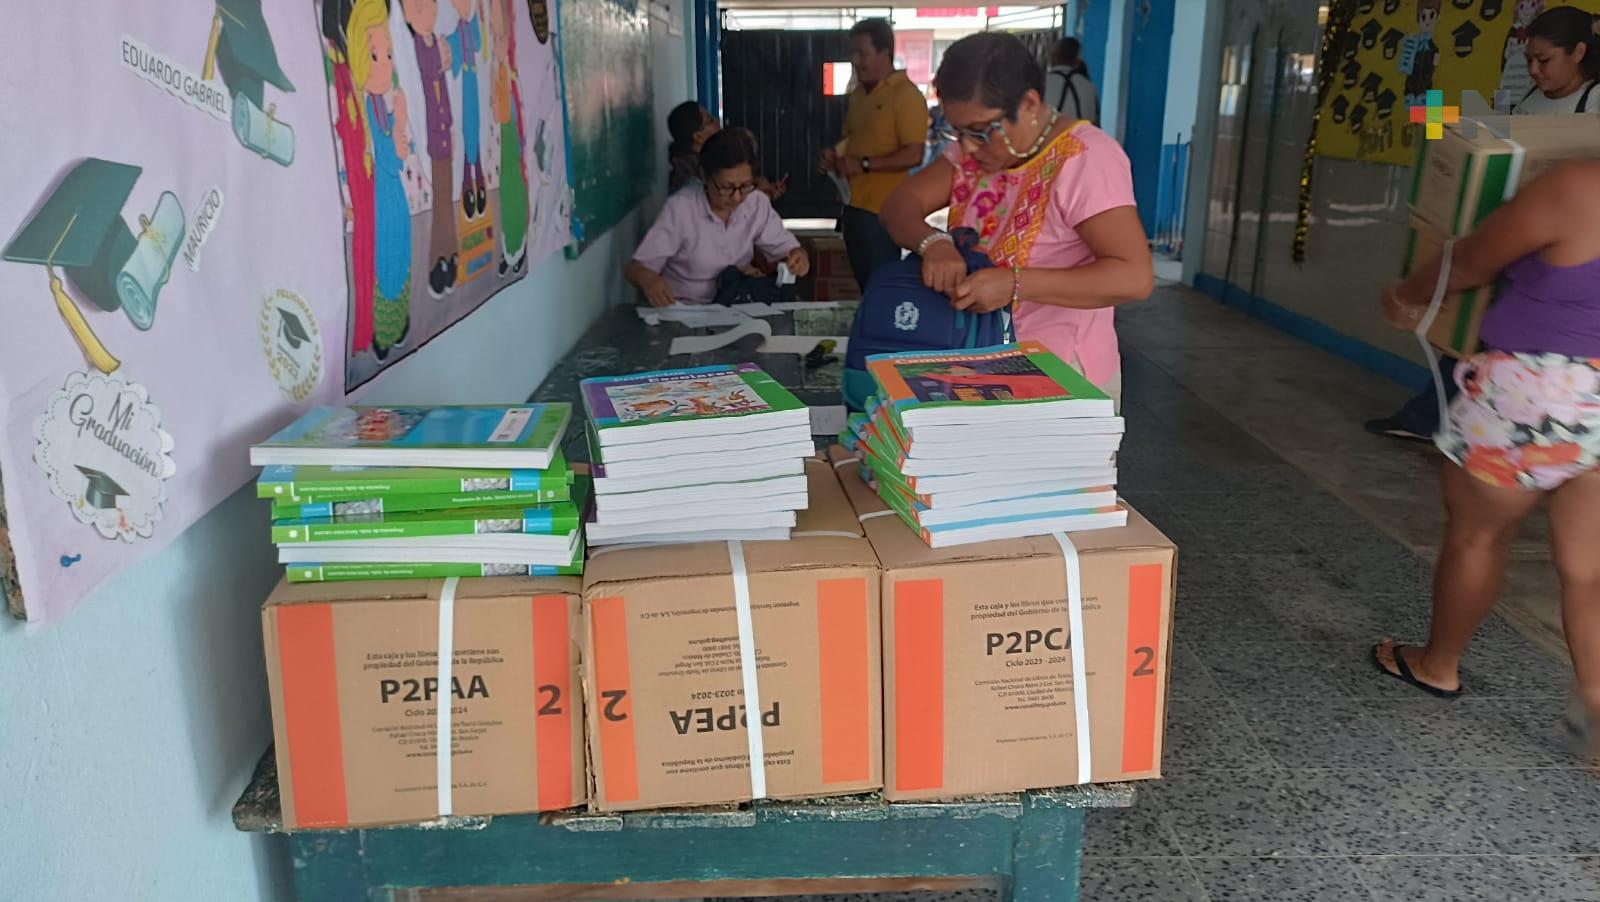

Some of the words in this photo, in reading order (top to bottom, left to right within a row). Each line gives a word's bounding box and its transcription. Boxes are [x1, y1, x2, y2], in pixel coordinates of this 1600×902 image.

[122, 41, 181, 90] EDUARDO
[184, 77, 227, 114] GABRIEL
[183, 189, 220, 267] MAURICIO
[648, 370, 734, 383] Escolares
[107, 392, 135, 434] Mi
[69, 393, 159, 477] Graduación
[971, 610, 1006, 620] propiedad
[1007, 609, 1017, 617] del
[1019, 608, 1049, 616] Gobierno
[990, 602, 1004, 610] caja
[1005, 659, 1023, 668] Ciclo
[1025, 658, 1042, 666] 2023
[1048, 656, 1066, 664] 2024
[1133, 646, 1154, 677] 2
[381, 675, 489, 703] P2PAA
[538, 684, 562, 716] 2
[405, 708, 425, 717] Ciclo
[601, 689, 627, 722] 2
